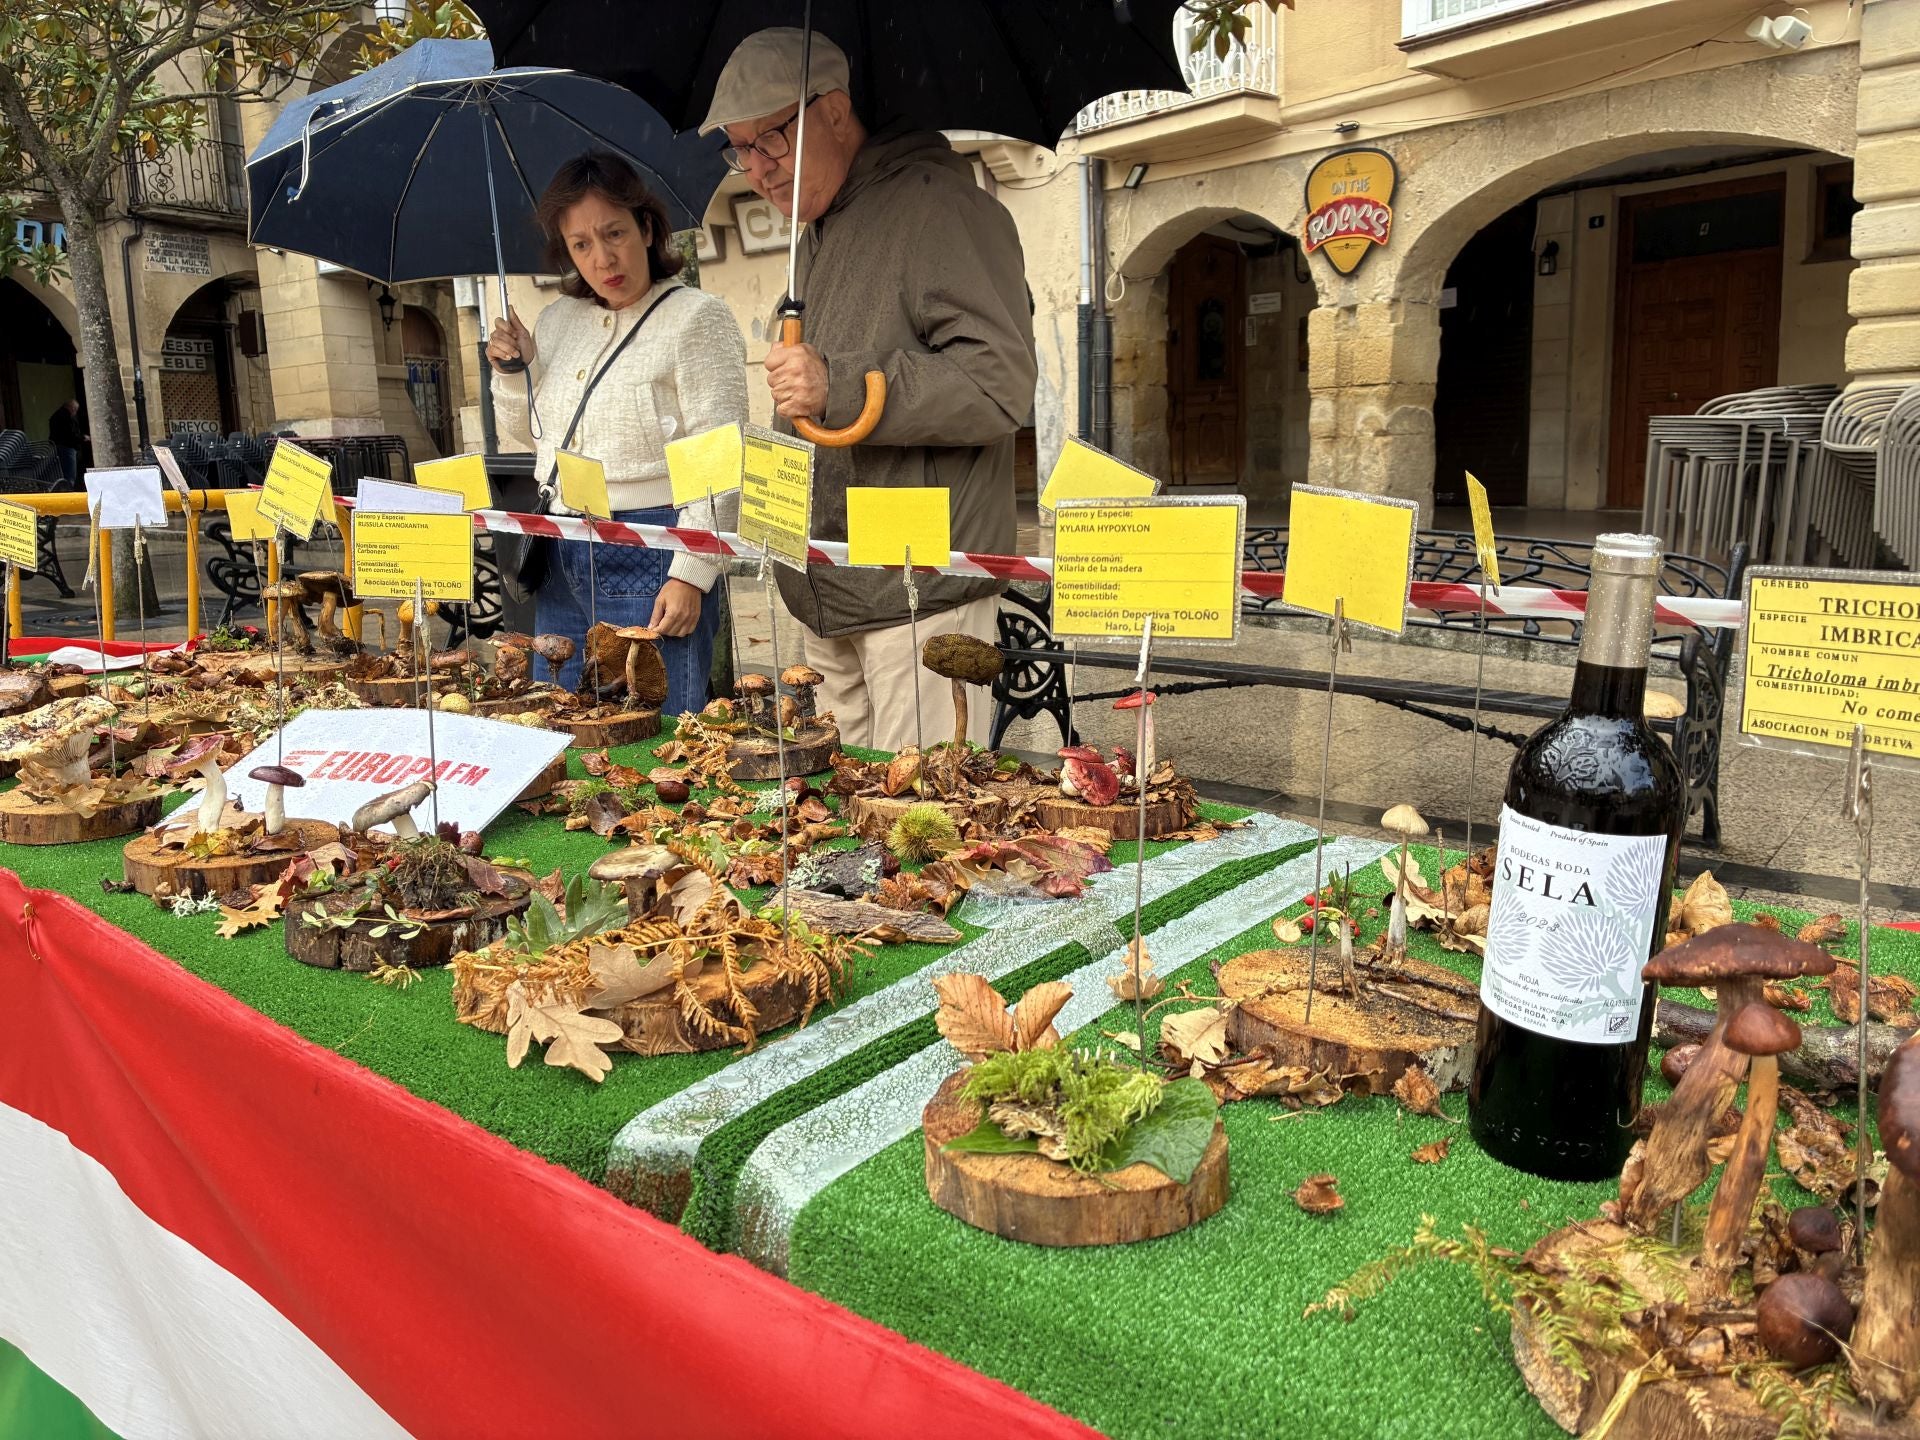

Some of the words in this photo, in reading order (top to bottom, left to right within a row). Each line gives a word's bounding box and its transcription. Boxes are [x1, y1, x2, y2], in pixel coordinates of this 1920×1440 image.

[1331, 181, 1347, 195] ON
[1350, 176, 1370, 193] THE
[182, 258, 209, 268] MULTA
[180, 266, 211, 275] PESETA
[783, 457, 808, 473] RUSSULA
[776, 469, 807, 487] DENSIFOLIA
[1058, 510, 1088, 518] Género
[1090, 511, 1095, 519] y
[1097, 510, 1133, 519] Especie:
[1059, 524, 1095, 533] XYLARIA
[1097, 524, 1150, 533] HYPOXYLON
[1056, 555, 1089, 563] Nombre
[1091, 555, 1123, 563] común:
[1058, 564, 1085, 573] Xilaria
[1087, 564, 1098, 572] de
[1100, 564, 1108, 572] la
[1110, 564, 1143, 573] madera
[364, 579, 400, 587] Asociación
[433, 581, 462, 589] TOLOÑO
[1055, 582, 1121, 591] Comestibilidad:
[1058, 592, 1070, 600] No
[1072, 592, 1118, 600] comestible
[1065, 608, 1119, 618] Asociación
[1173, 609, 1219, 621] TOLOÑO
[1759, 613, 1807, 623] ESPECIE
[1105, 622, 1131, 632] Haro,
[1151, 622, 1175, 634] Rioja
[1761, 647, 1810, 658] NOMBRE
[1816, 651, 1859, 662] COMUN
[1767, 663, 1867, 687] Tricholoma
[1756, 679, 1860, 698] COMESTIBILIDAD:
[1841, 700, 1868, 716] No
[1751, 718, 1829, 738] ASOCIACION
[1835, 730, 1913, 750] DEORTIVA
[445, 761, 491, 787] FM
[1521, 821, 1541, 833] Bottled
[1550, 830, 1577, 842] Product
[1578, 836, 1588, 846] of
[1587, 837, 1609, 848] Spain
[1510, 845, 1550, 867] BODEGAS
[1555, 861, 1591, 876] RODA
[1502, 857, 1598, 908] SELA
[1516, 911, 1560, 932] 2023
[1518, 973, 1540, 987] RIOJA
[1530, 988, 1549, 998] origen
[1550, 994, 1583, 1005] calificada
[1493, 992, 1523, 1012] BODEGAS
[1551, 1016, 1568, 1026] S.A.
[1540, 1005, 1573, 1018] PROPIEDAD
